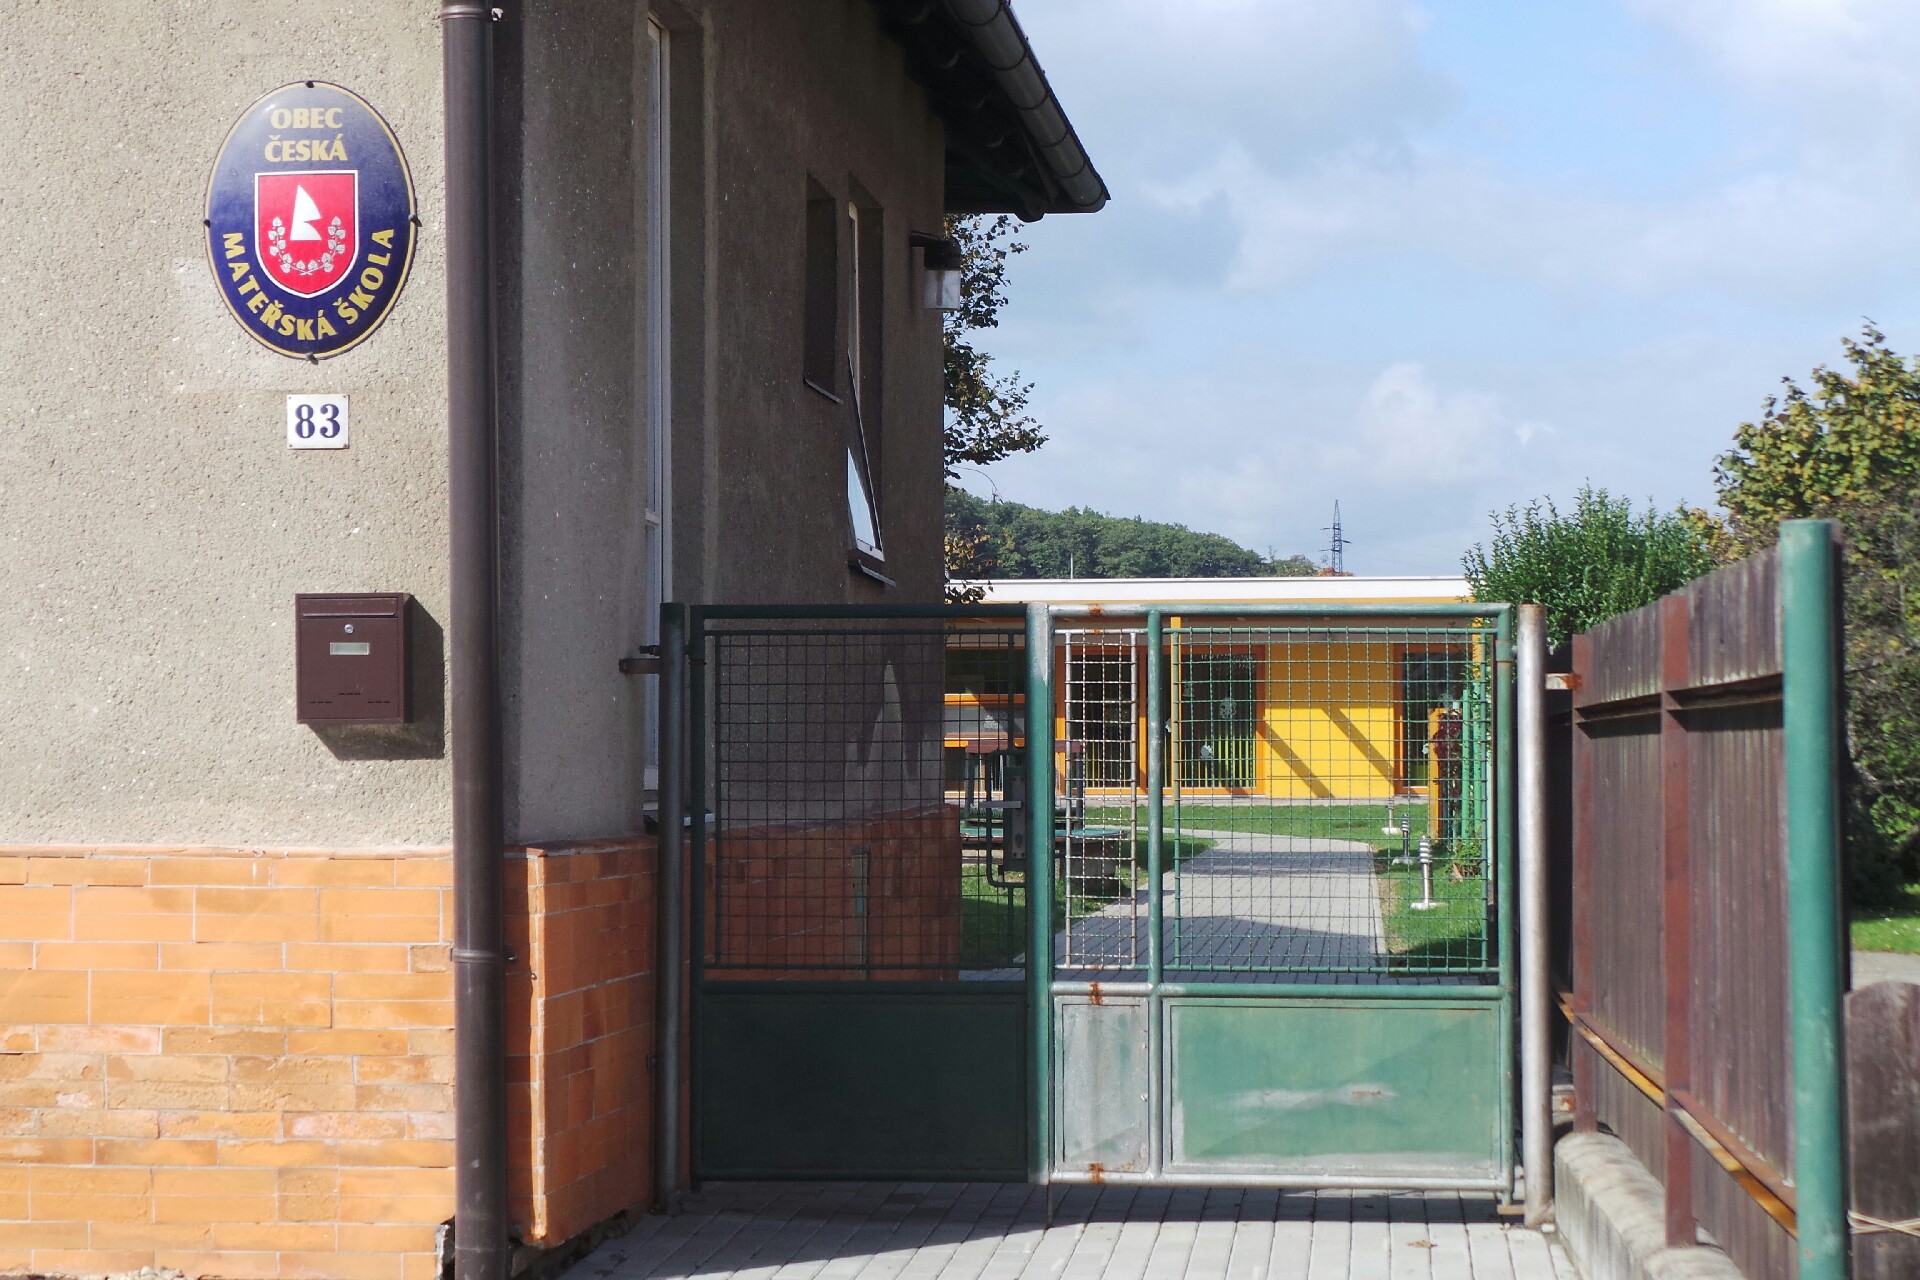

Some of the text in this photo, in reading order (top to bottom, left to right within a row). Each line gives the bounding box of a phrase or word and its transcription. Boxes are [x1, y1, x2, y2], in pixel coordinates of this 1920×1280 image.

[271, 107, 343, 129] OBEC
[264, 133, 348, 162] ČESKÁ
[223, 229, 394, 340] MATEŘSKÁ ŠKOLA
[295, 403, 340, 438] 83
